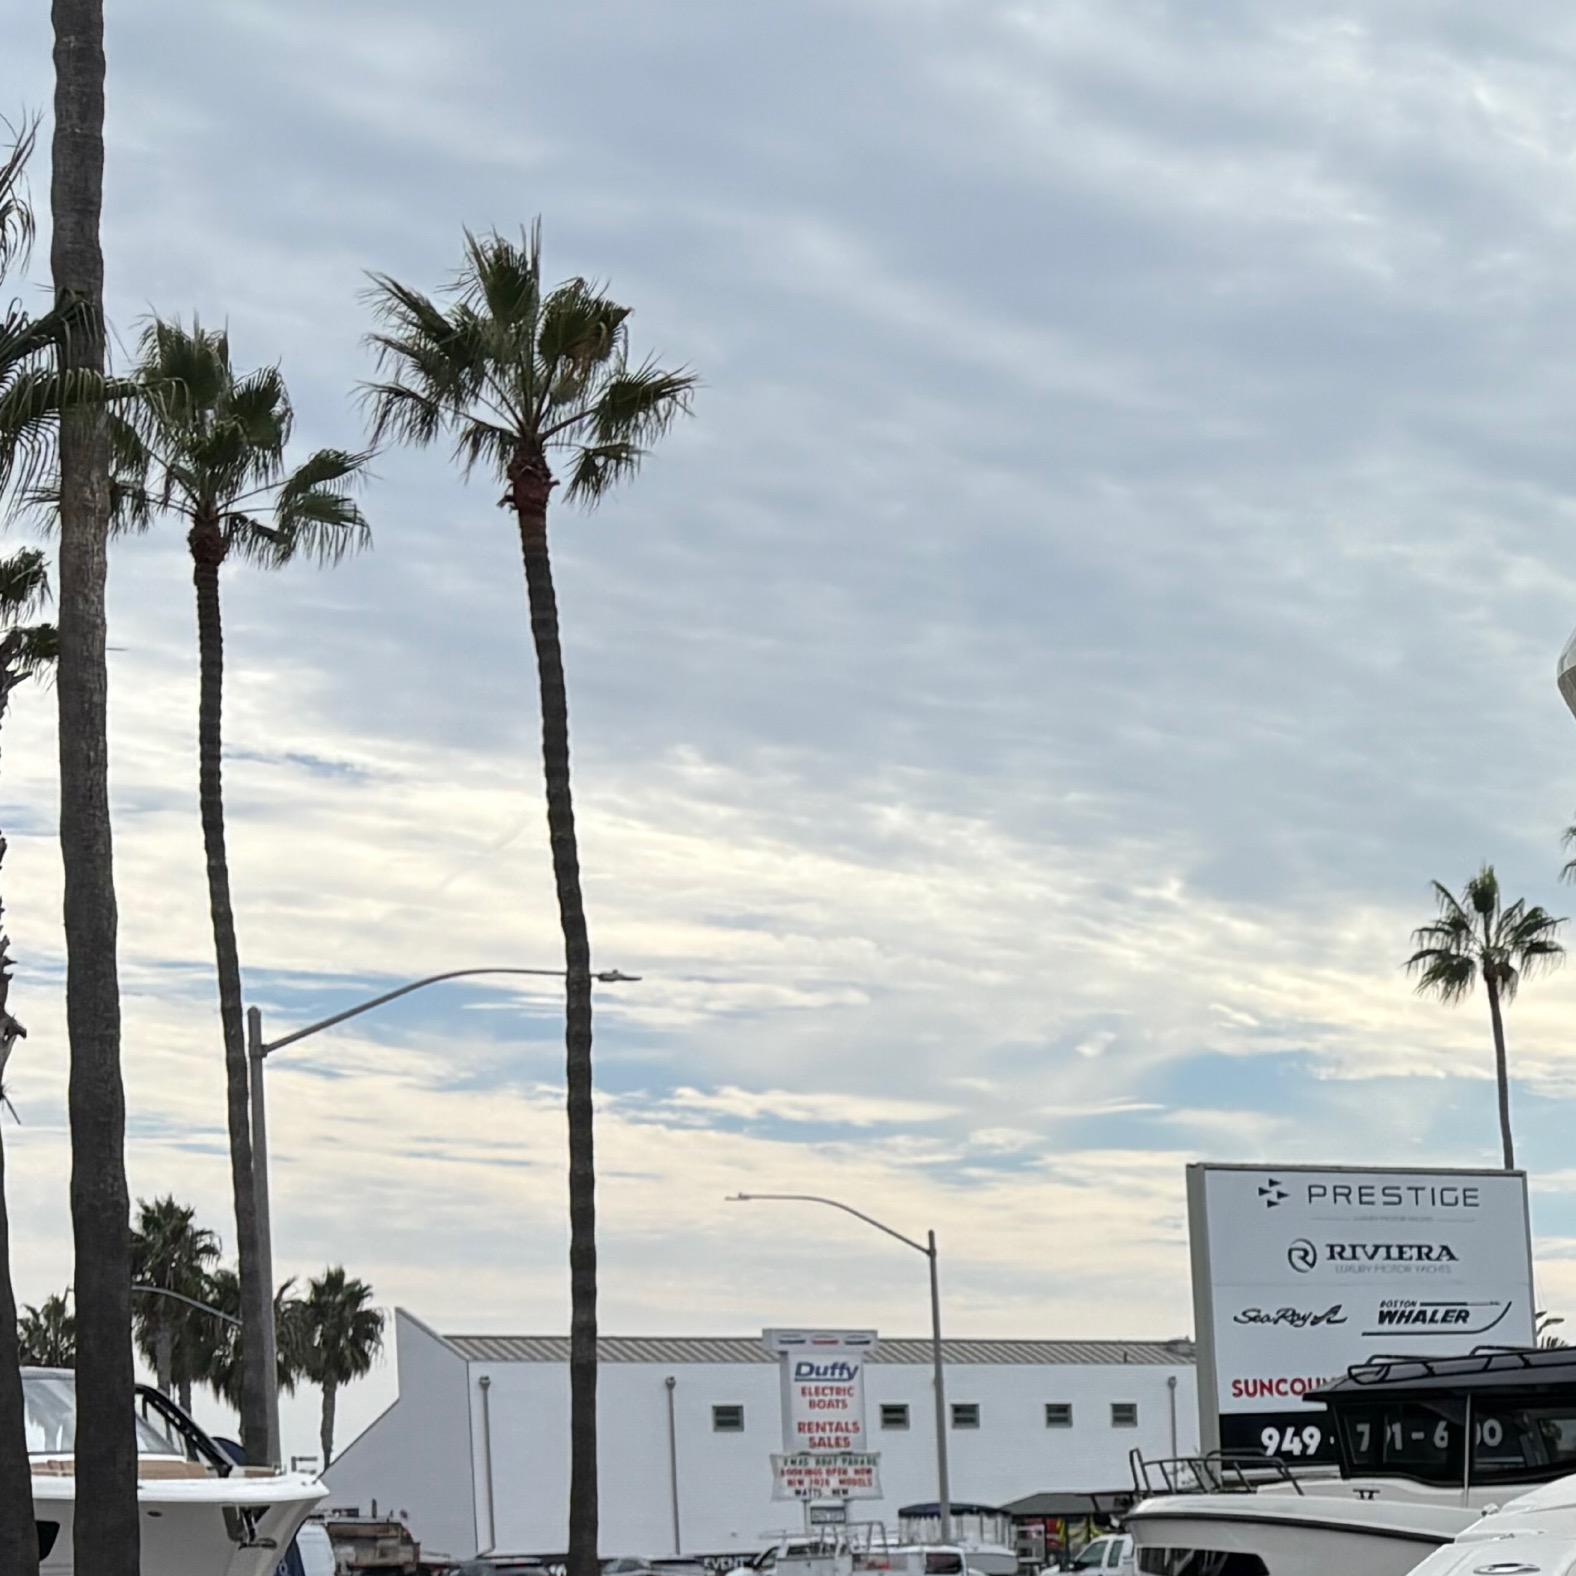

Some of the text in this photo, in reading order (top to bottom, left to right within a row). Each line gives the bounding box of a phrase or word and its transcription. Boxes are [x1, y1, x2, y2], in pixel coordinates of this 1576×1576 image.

[1307, 1184, 1480, 1207] PRESTIGE
[1325, 1243, 1459, 1262] RIVIERA
[1379, 1299, 1417, 1308] BOSTON
[1377, 1308, 1470, 1325] WHALER
[794, 1361, 859, 1381] Duffy
[800, 1385, 855, 1398] ELECTRIC
[808, 1398, 849, 1410] BOATS
[797, 1421, 861, 1434] RENTALS
[808, 1436, 851, 1449] SALES
